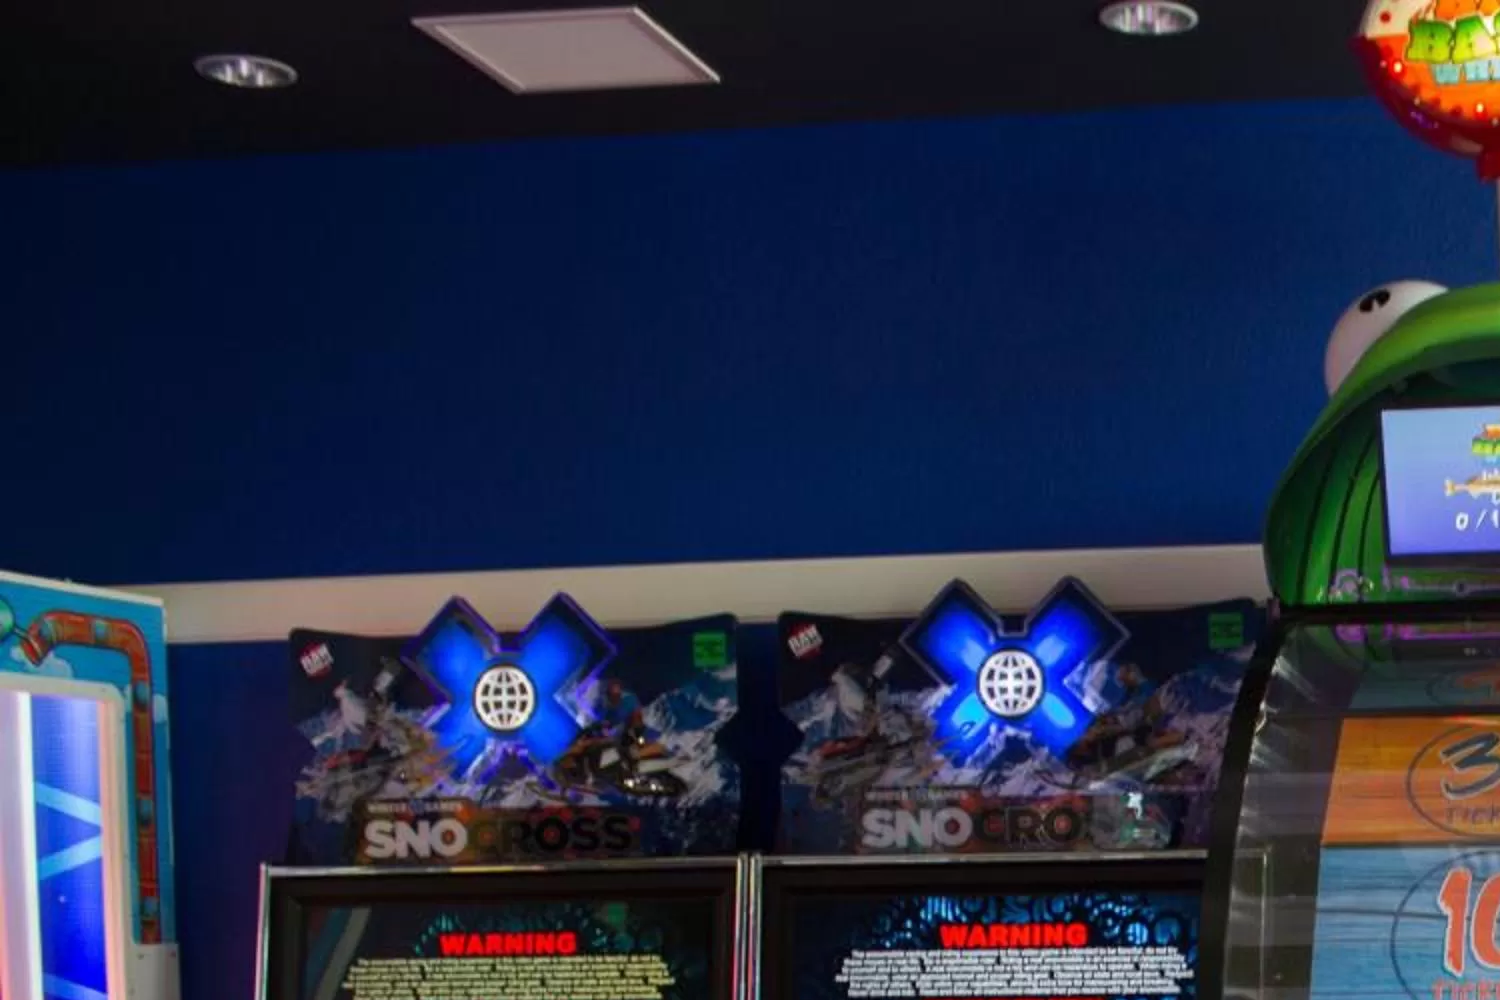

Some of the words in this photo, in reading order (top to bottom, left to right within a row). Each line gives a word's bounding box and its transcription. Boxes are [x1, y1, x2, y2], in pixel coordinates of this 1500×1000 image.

[1455, 512, 1469, 531] 0
[440, 932, 578, 955] WARNING
[939, 923, 1089, 947] WARNING
